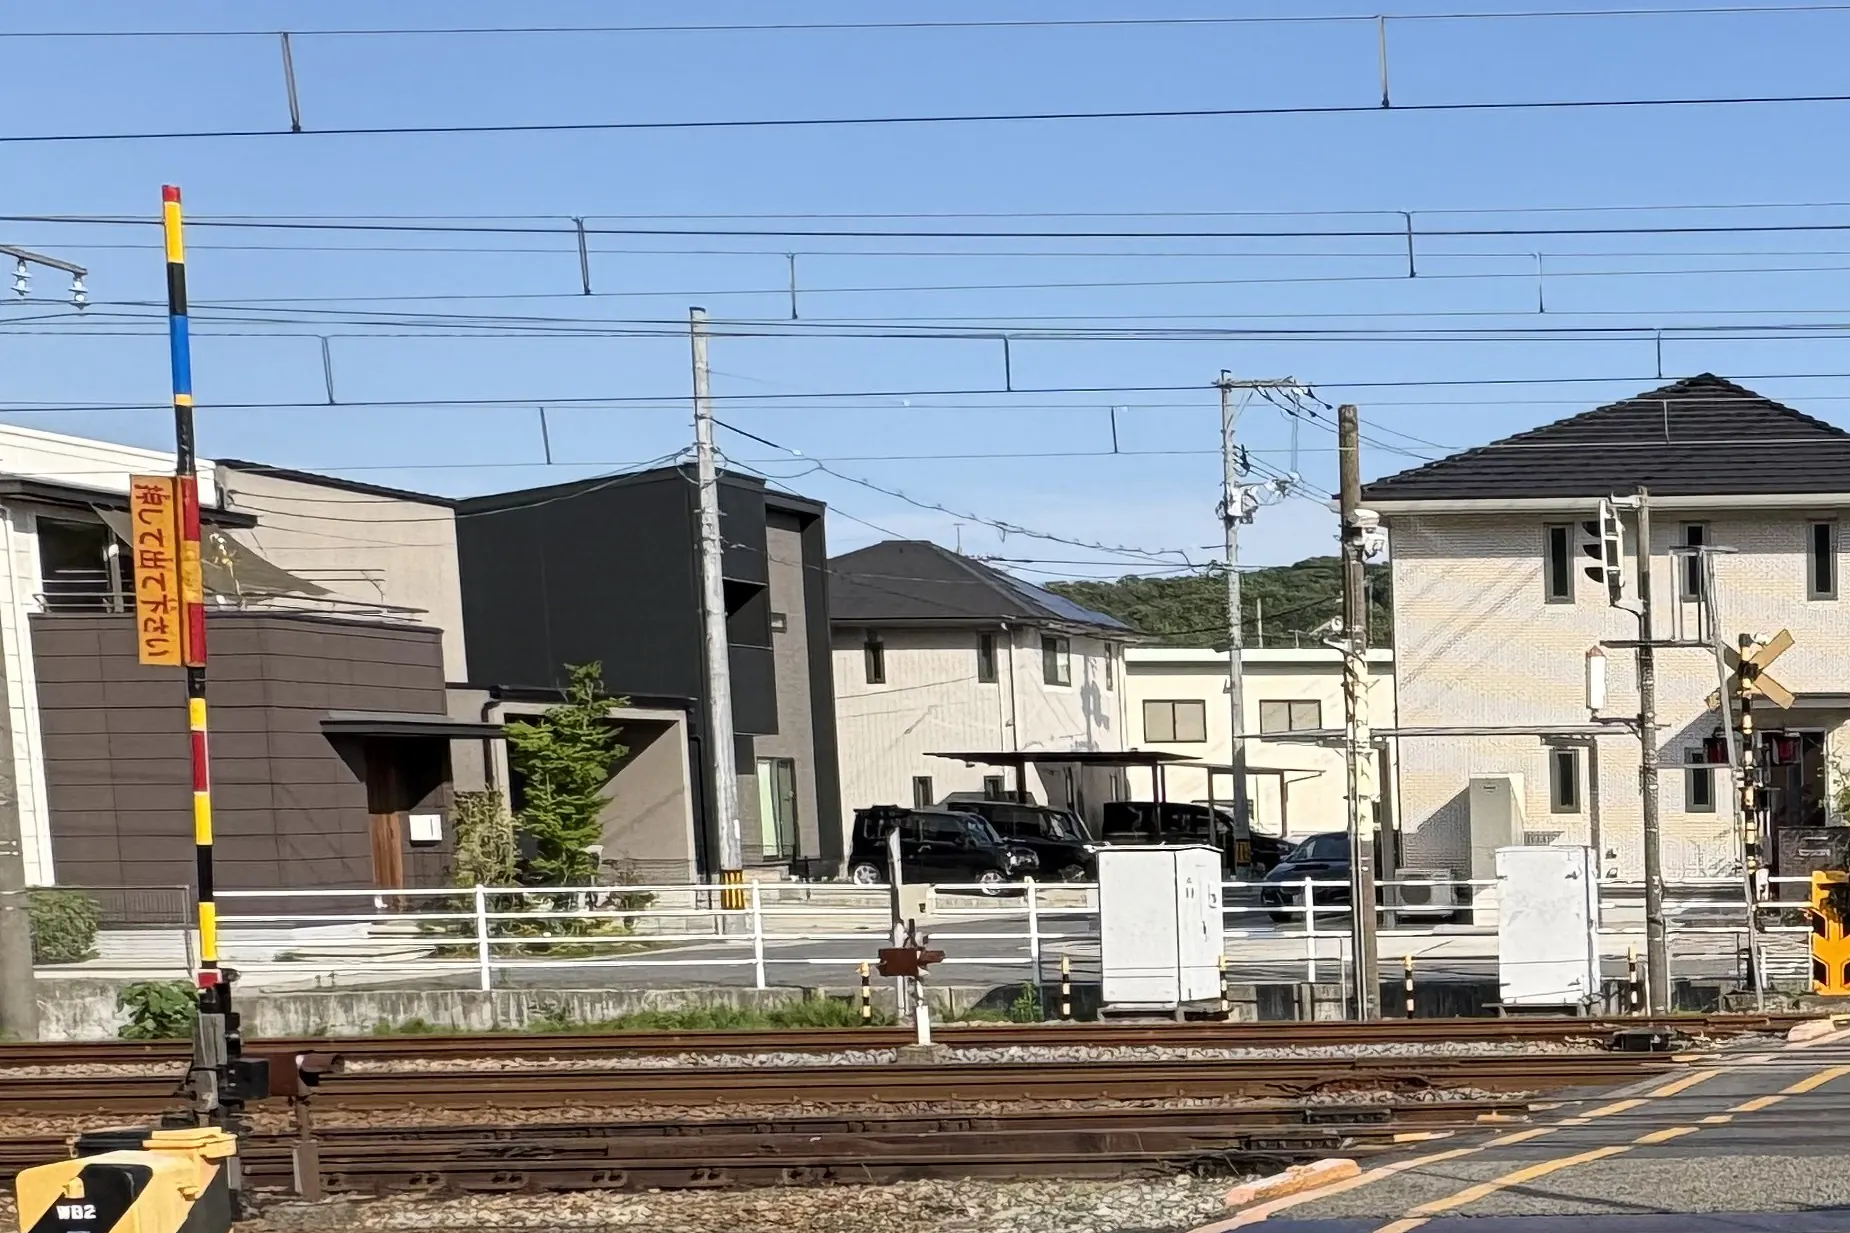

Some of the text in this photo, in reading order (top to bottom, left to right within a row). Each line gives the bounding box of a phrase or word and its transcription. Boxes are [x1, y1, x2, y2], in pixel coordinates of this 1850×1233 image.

[134, 483, 177, 657] 押して出て下さい
[56, 1204, 97, 1220] WB2
